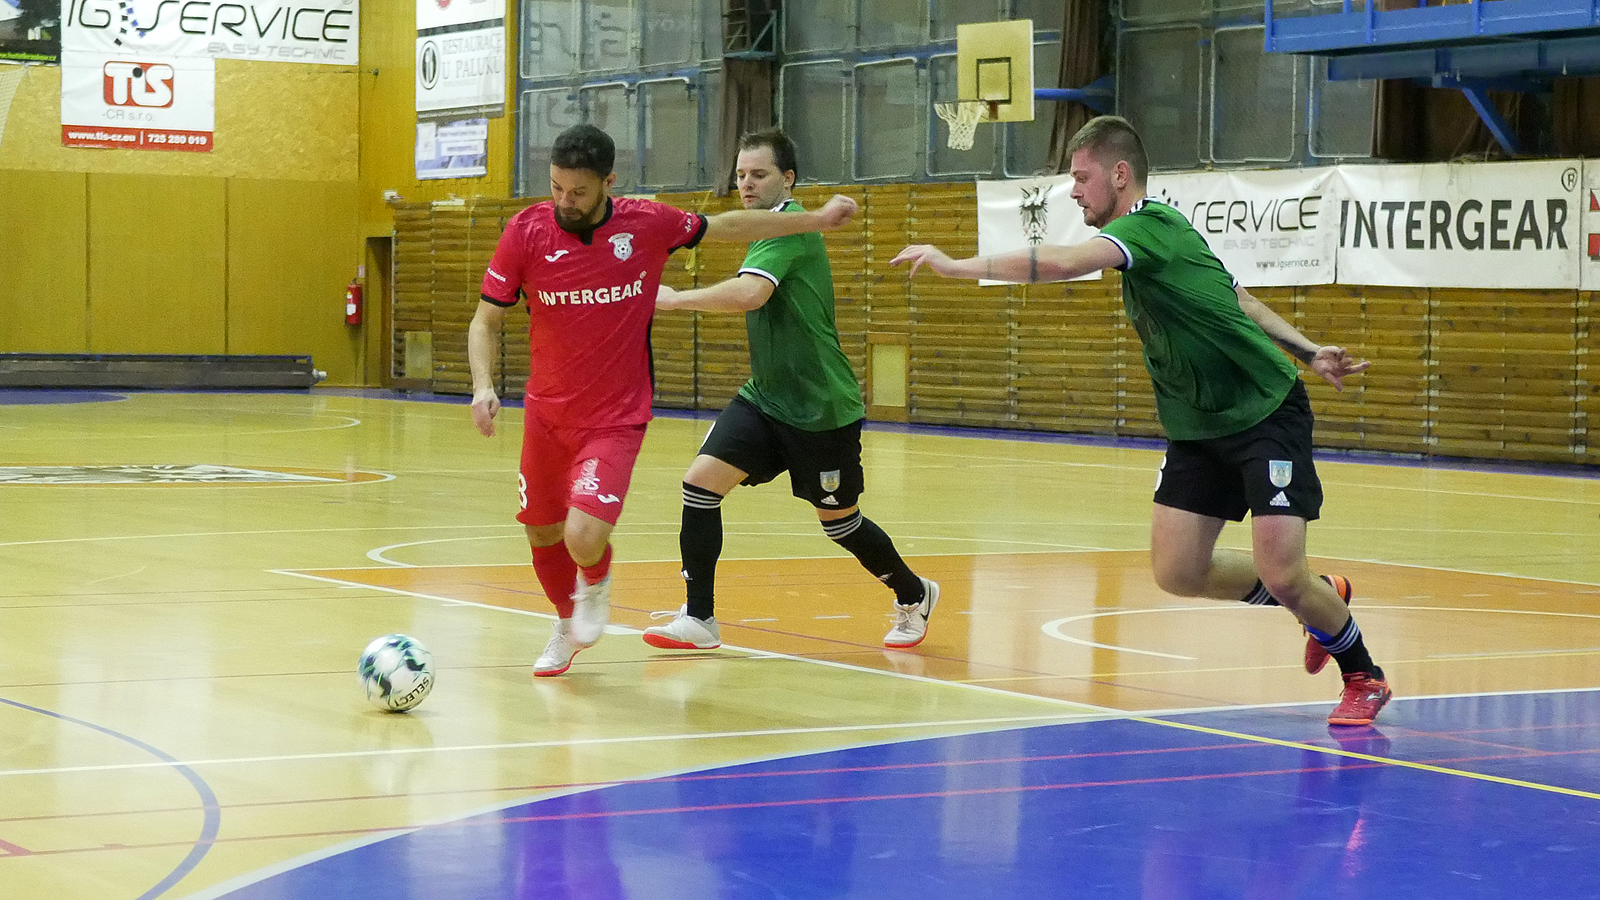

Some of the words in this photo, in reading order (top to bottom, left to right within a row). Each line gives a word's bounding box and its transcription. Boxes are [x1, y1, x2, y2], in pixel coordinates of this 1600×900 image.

[136, 0, 353, 43] SERVICE
[207, 42, 260, 55] EASY
[266, 45, 347, 60] TECHNIC
[442, 33, 502, 55] RESTAURACE
[147, 133, 166, 143] 725
[1339, 199, 1569, 251] INTERGEAR
[1256, 259, 1320, 271] www.igservice.cz
[538, 280, 643, 306] INTERGEAR
[394, 676, 430, 707] SELECT
